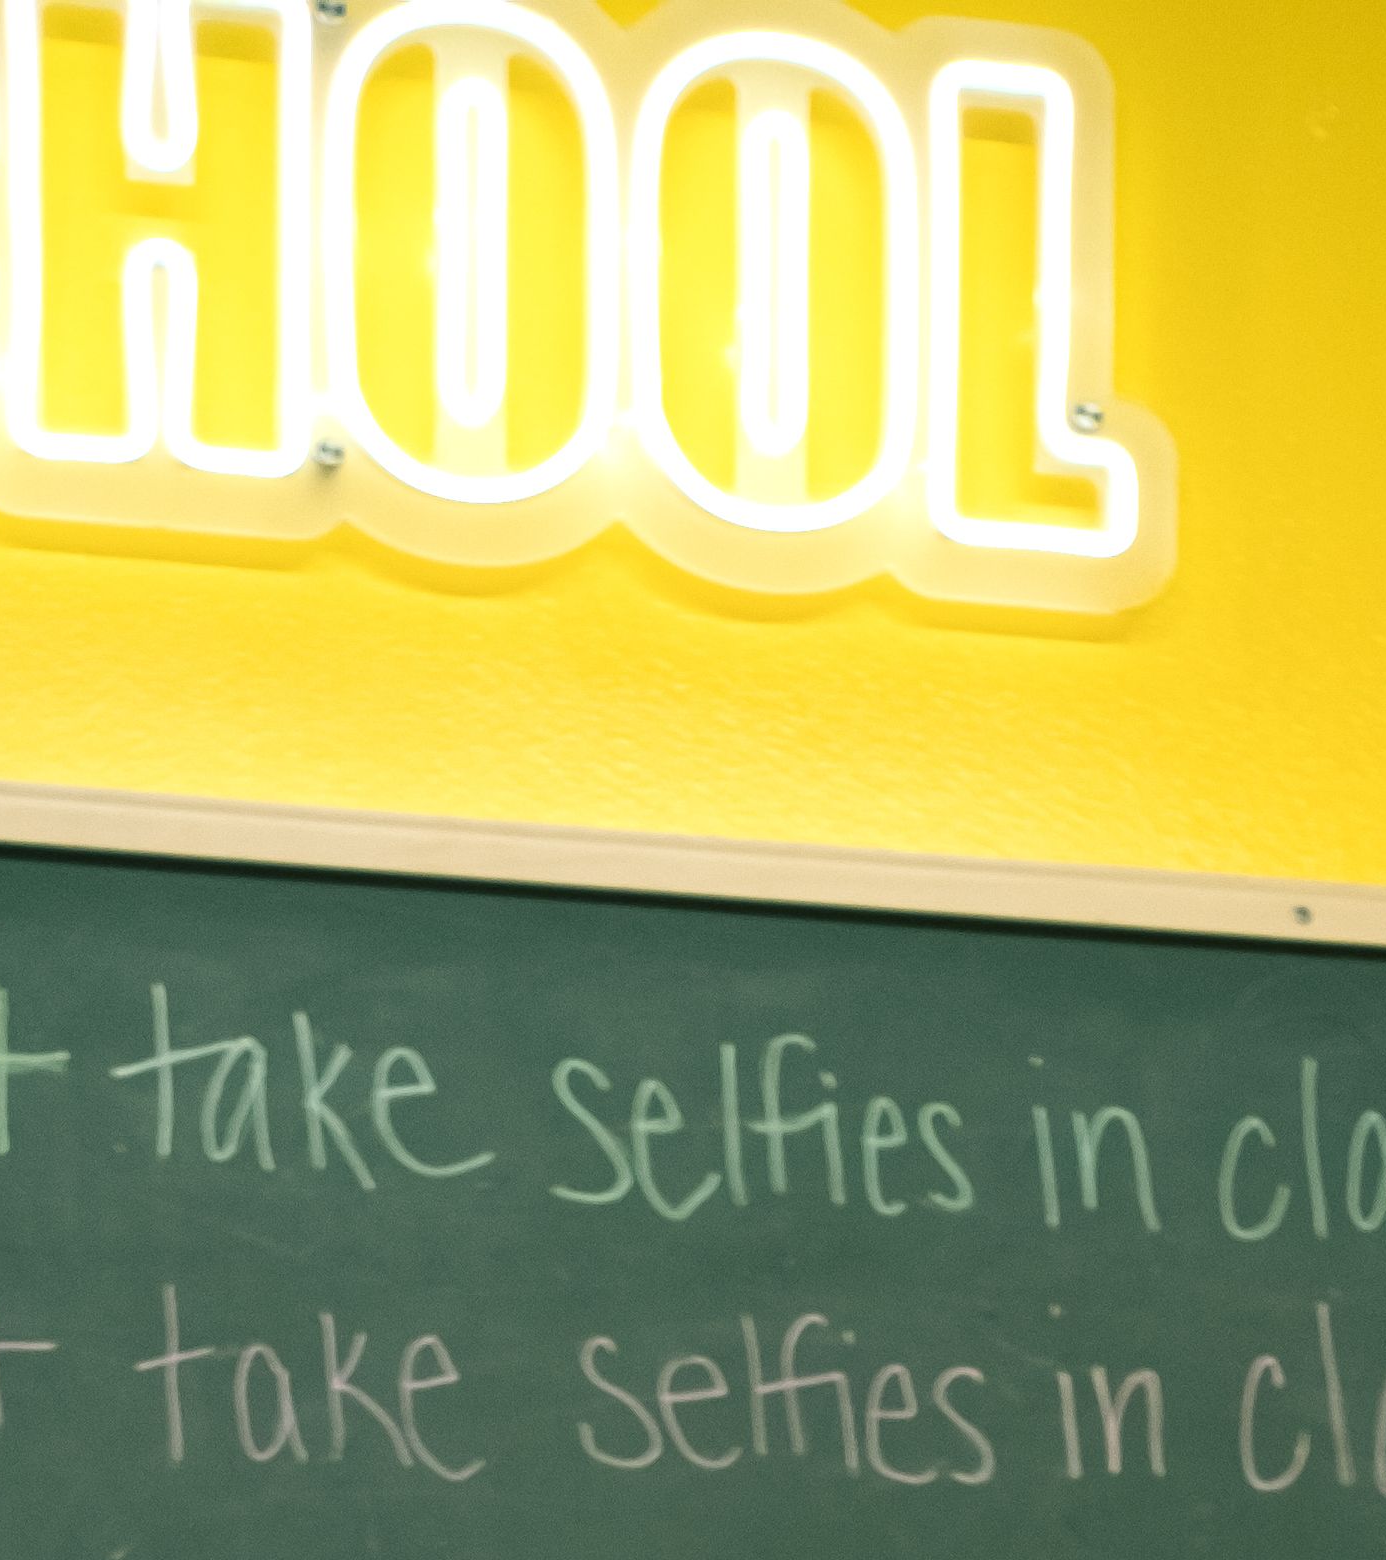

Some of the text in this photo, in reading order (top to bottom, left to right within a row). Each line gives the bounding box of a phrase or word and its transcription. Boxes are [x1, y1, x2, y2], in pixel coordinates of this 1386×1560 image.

[109, 982, 495, 1190] take
[551, 1033, 975, 1220] selfies
[1028, 1056, 1161, 1232] in
[132, 1282, 487, 1482] take
[576, 1312, 995, 1485] selfies
[1047, 1303, 1166, 1478] in
